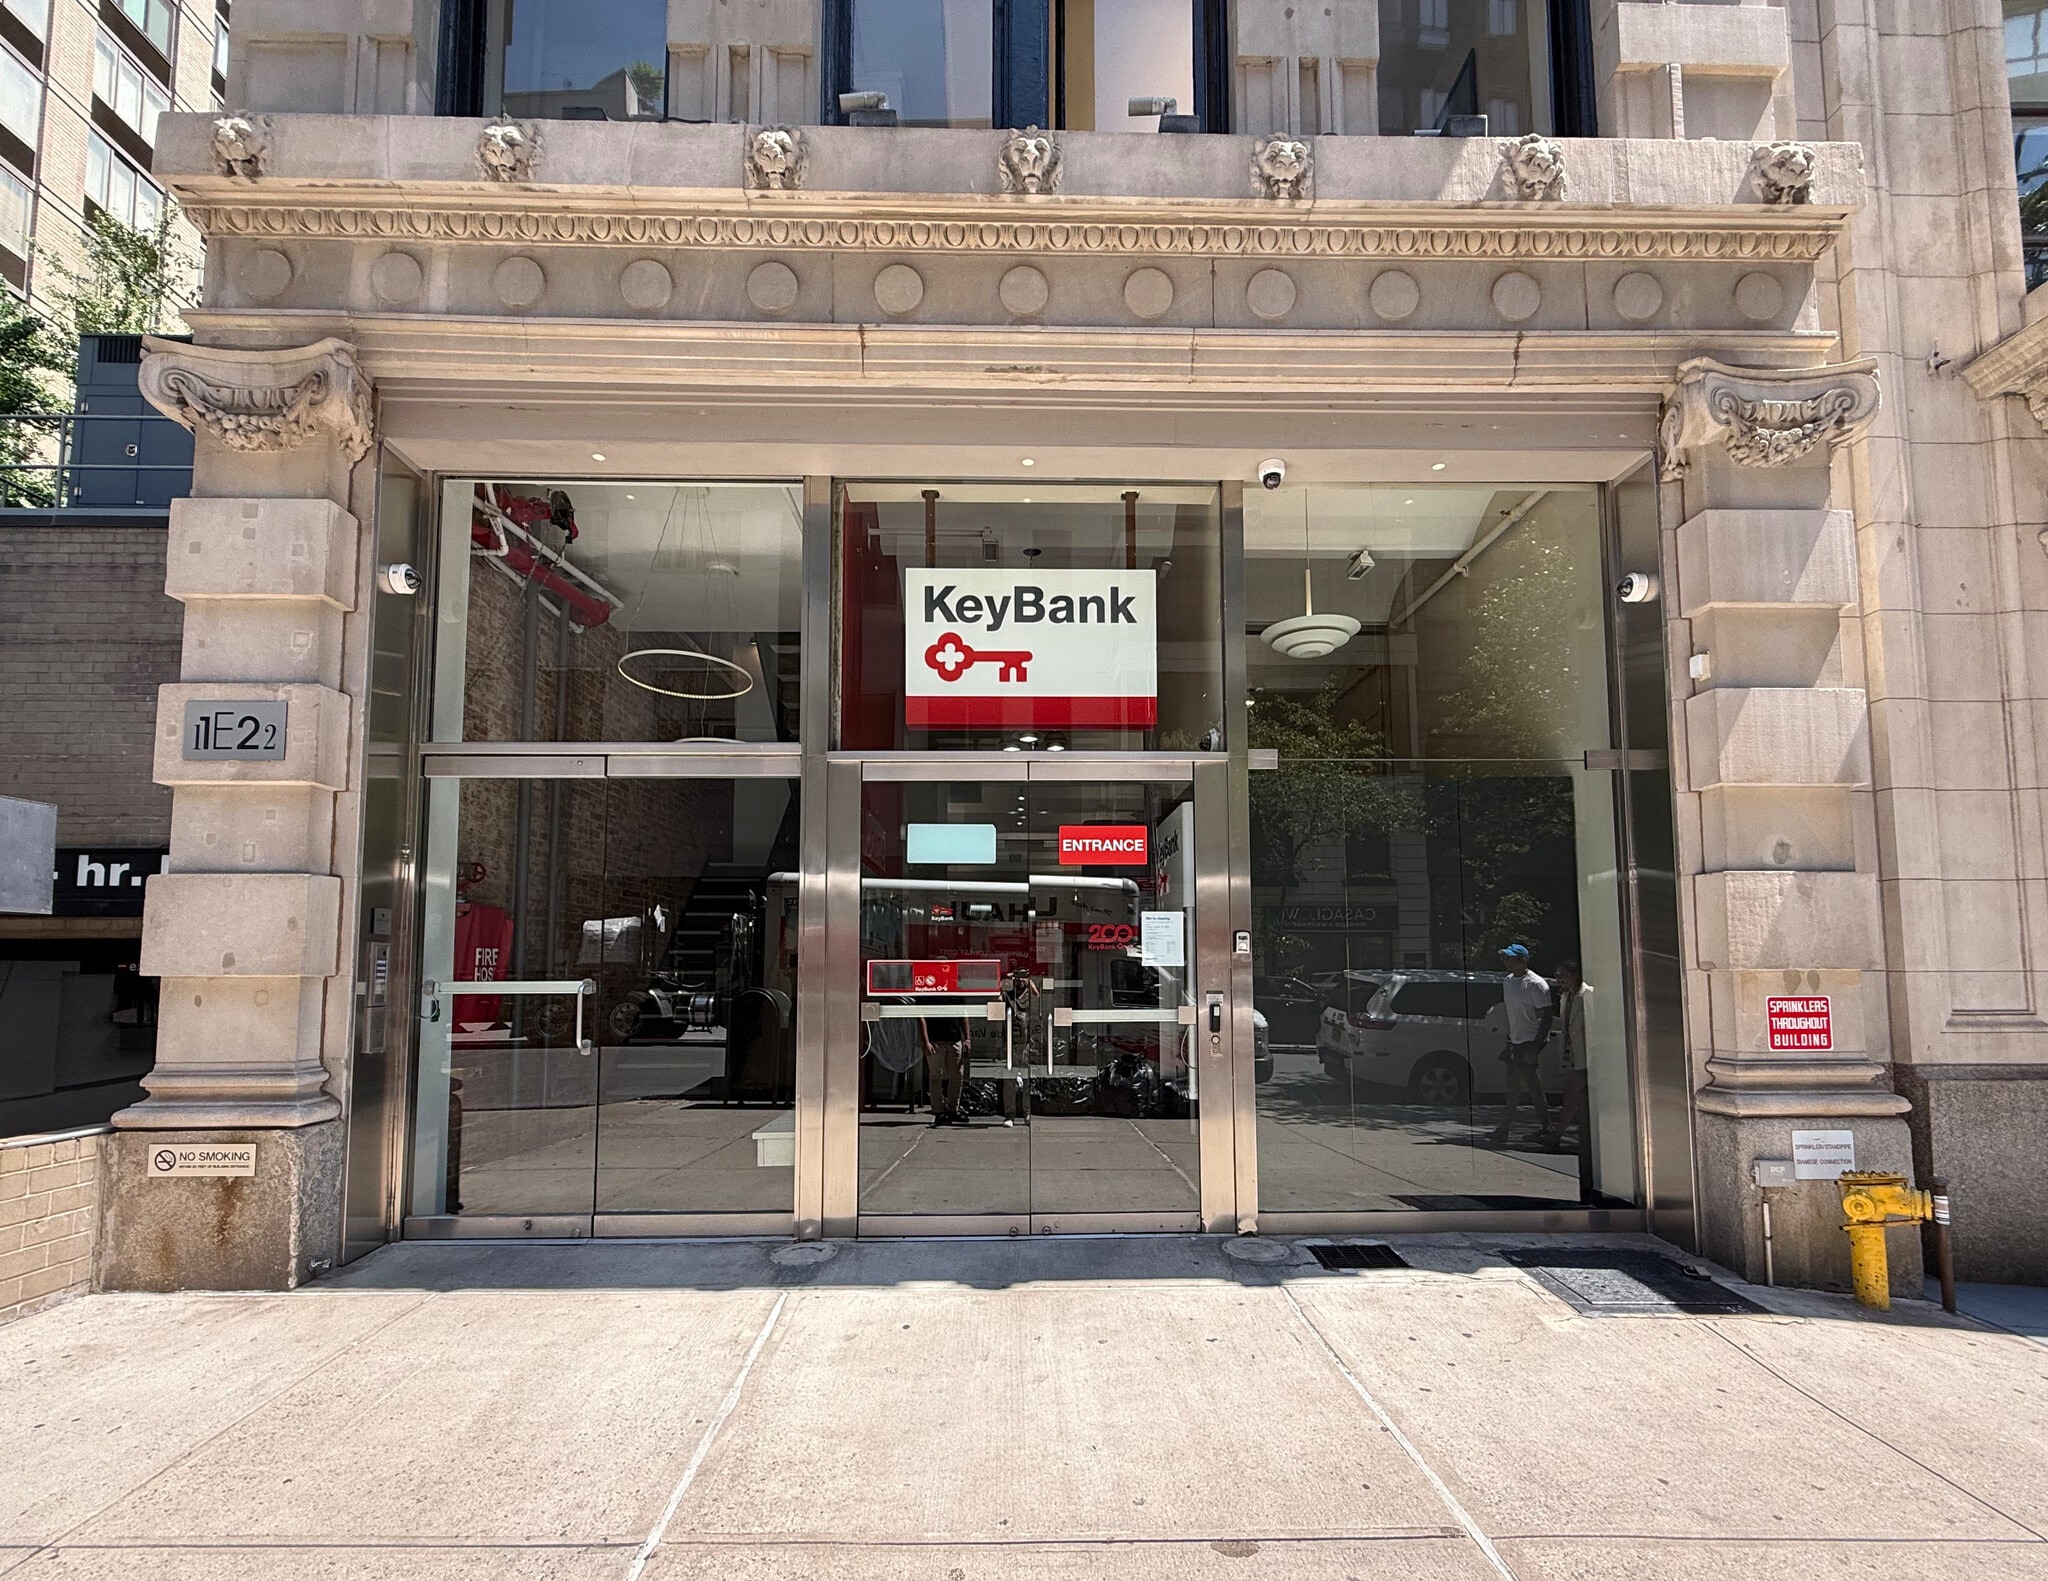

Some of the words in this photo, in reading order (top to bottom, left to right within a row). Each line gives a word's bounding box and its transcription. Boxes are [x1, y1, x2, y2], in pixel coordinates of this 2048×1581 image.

[924, 585, 1138, 632] KeyBank
[1062, 838, 1145, 852] ENTRANCE
[76, 854, 142, 887] hr.
[931, 915, 954, 923] KeyBank
[1088, 924, 1133, 943] 200
[1088, 943, 1116, 951] KeyBank
[475, 947, 499, 966] FIRE
[474, 967, 496, 981] HOS
[1769, 1000, 1828, 1013] SPRINKLERS
[1770, 1016, 1828, 1030] THROUGHOUT
[1773, 1034, 1828, 1046] BUILDING
[179, 1151, 195, 1162] NO
[198, 1151, 250, 1162] SMOKING
